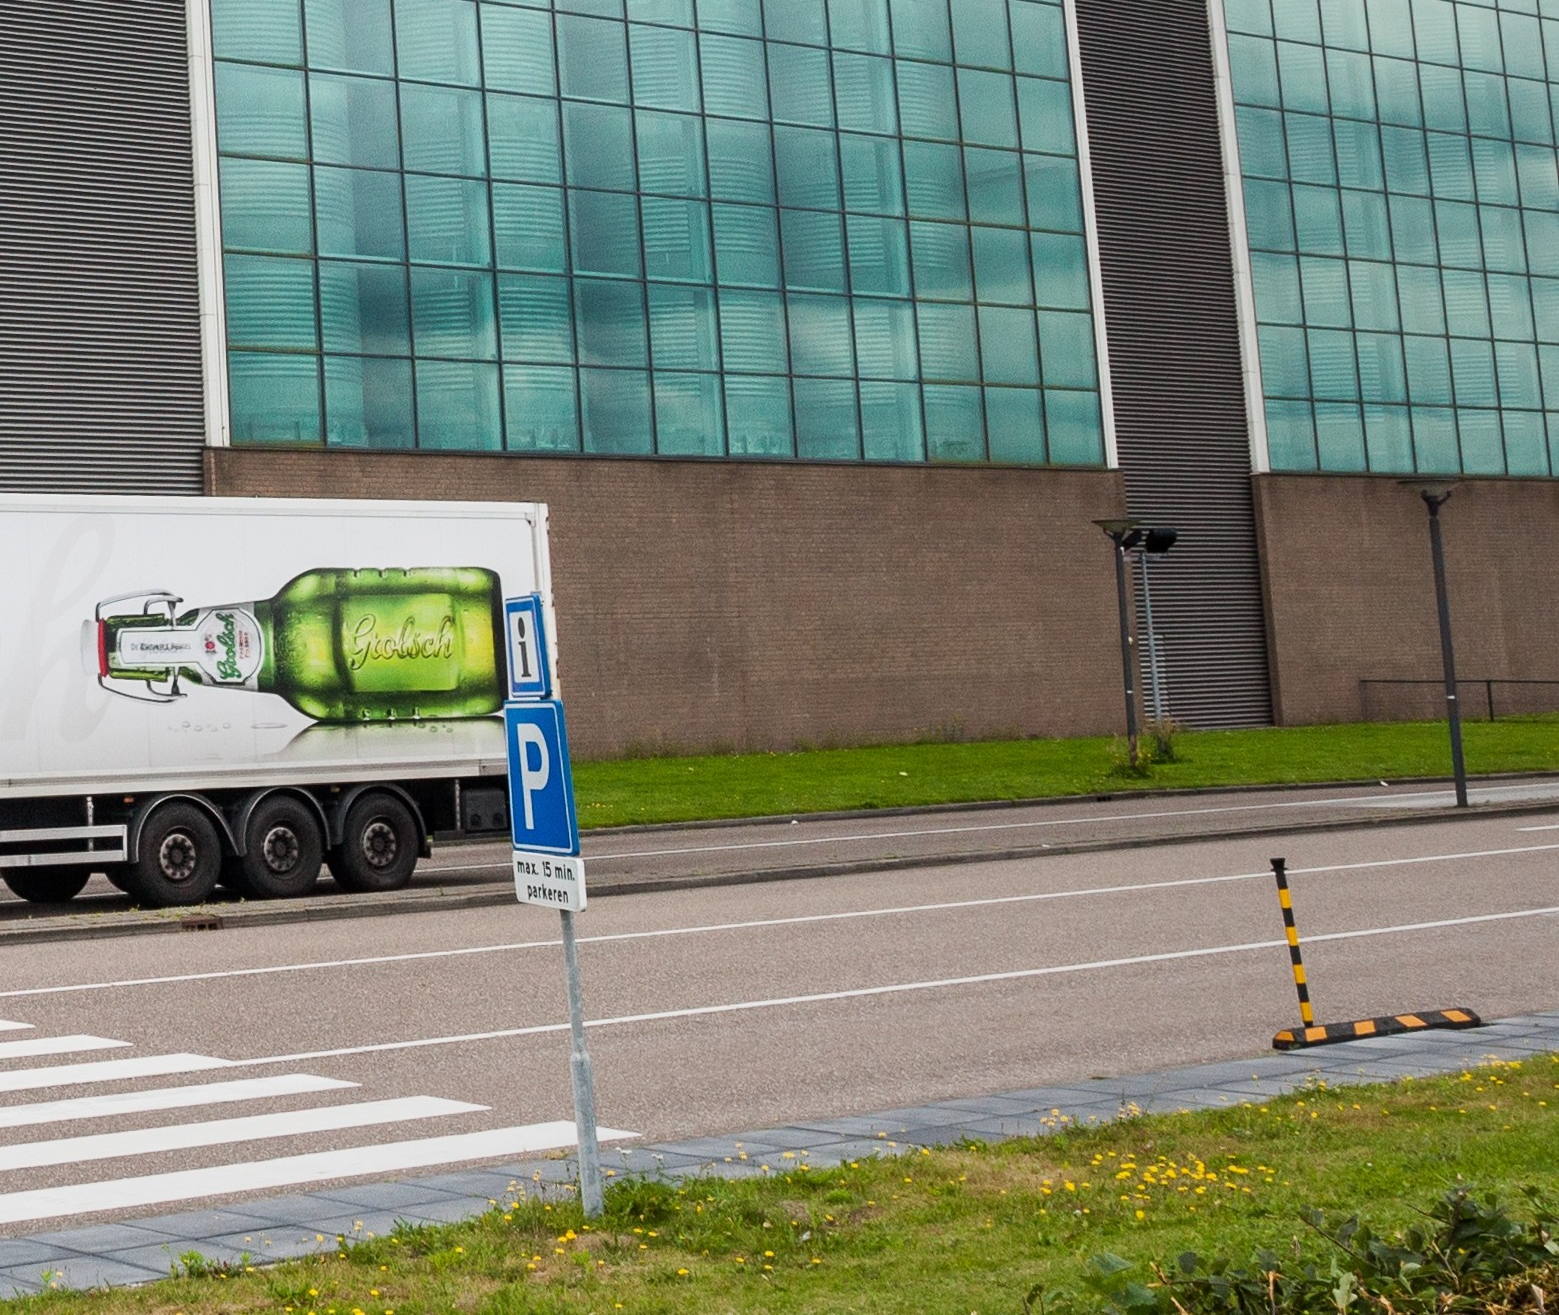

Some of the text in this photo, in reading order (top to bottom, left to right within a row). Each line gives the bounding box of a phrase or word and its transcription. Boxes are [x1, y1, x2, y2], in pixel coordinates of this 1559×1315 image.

[215, 612, 243, 680] Grolsch
[349, 613, 457, 671] Grolsch
[517, 723, 550, 830] P
[517, 861, 575, 881] max. 15 min.
[527, 884, 569, 903] parkeren
